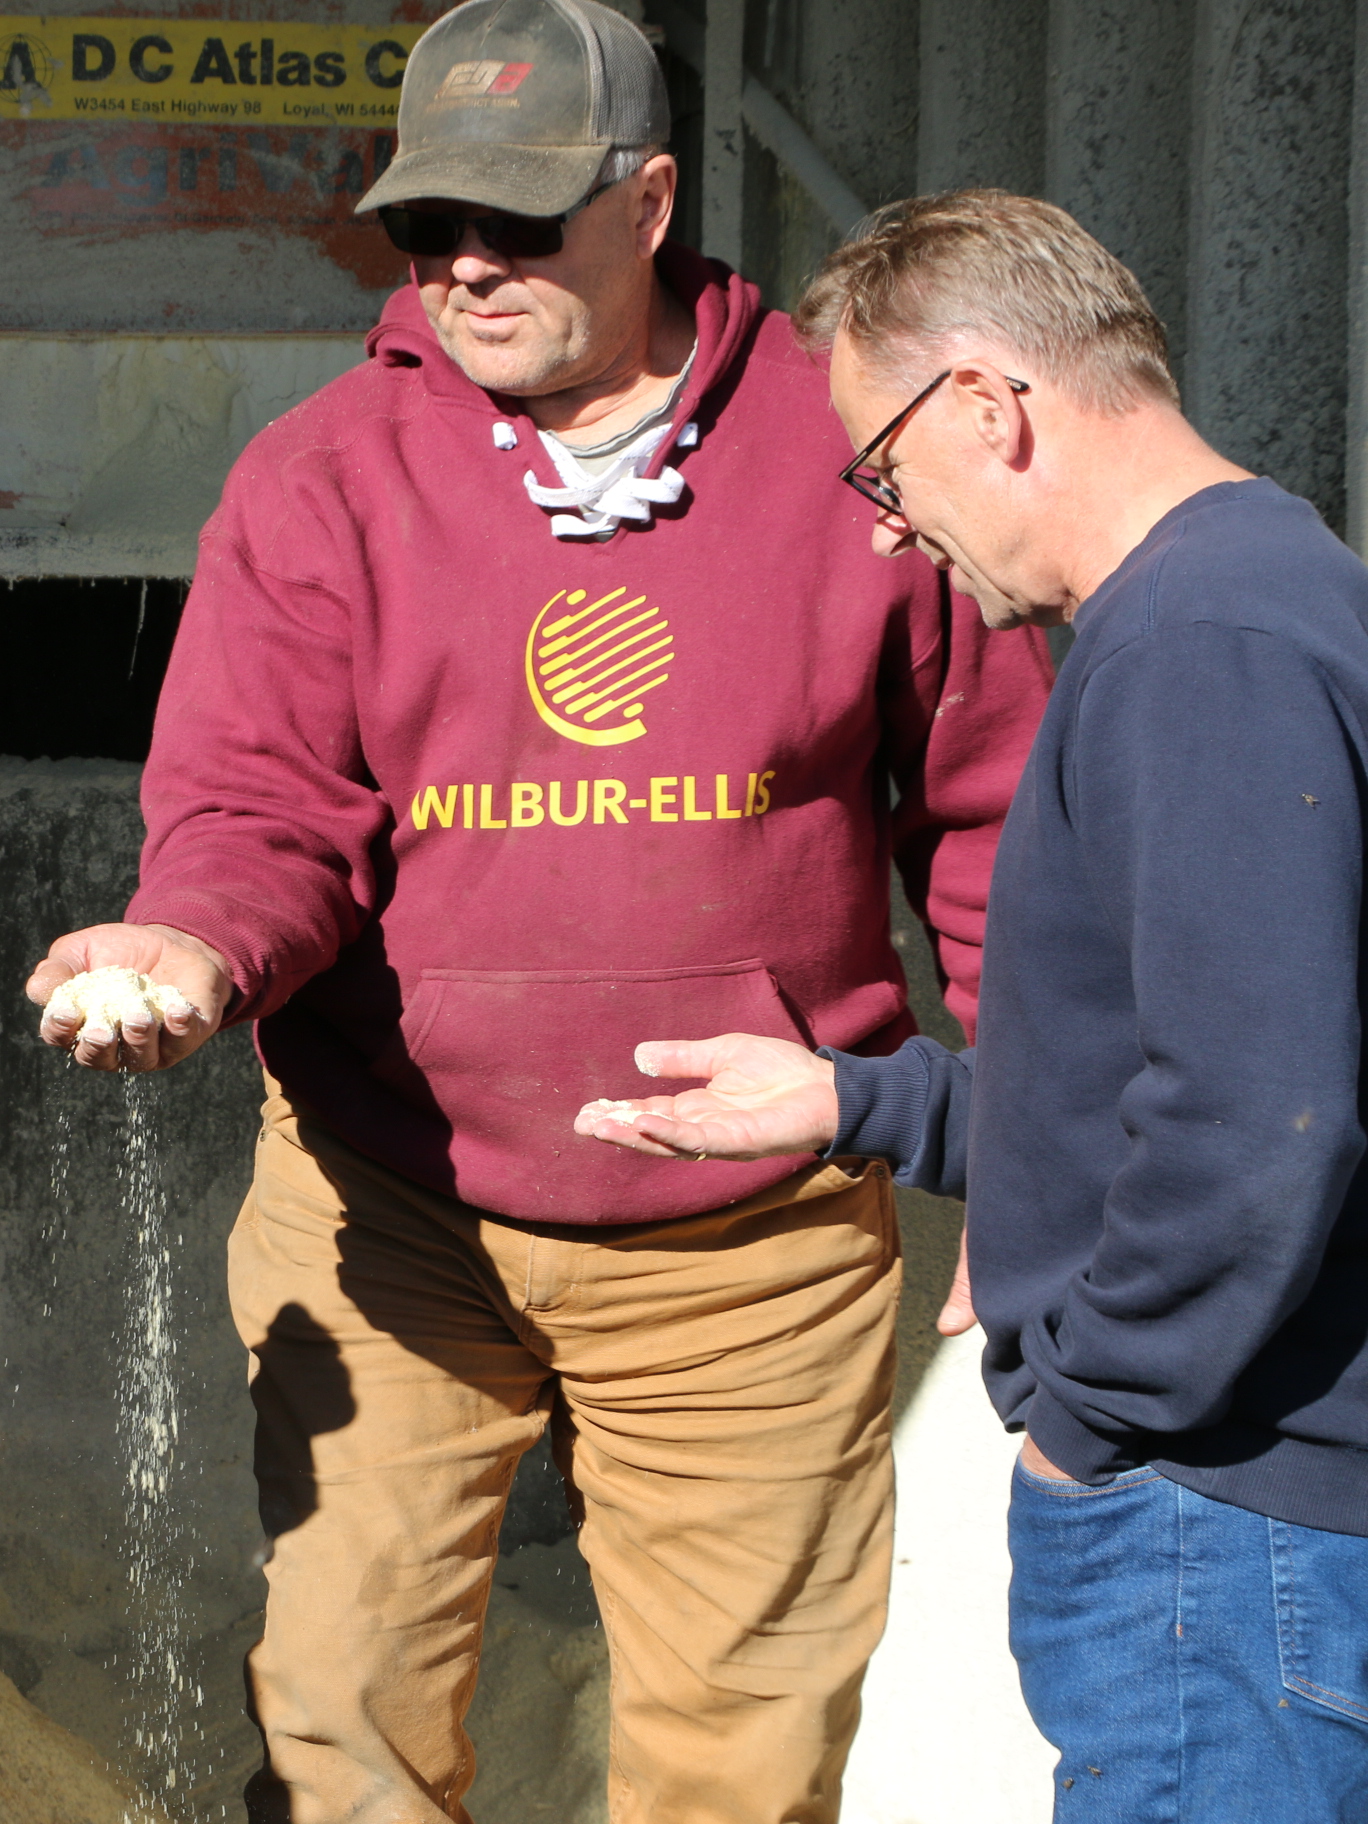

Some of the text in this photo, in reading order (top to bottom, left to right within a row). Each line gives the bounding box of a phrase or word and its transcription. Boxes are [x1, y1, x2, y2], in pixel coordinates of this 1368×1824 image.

[72, 34, 116, 82] D
[129, 35, 174, 83] C
[191, 37, 347, 88] Atlas
[74, 97, 125, 112] W3454
[131, 98, 167, 114] East
[171, 99, 238, 116] Highway
[243, 101, 262, 115] 98
[335, 102, 355, 116] WI
[411, 770, 776, 830] WILBUR-ELLIS
